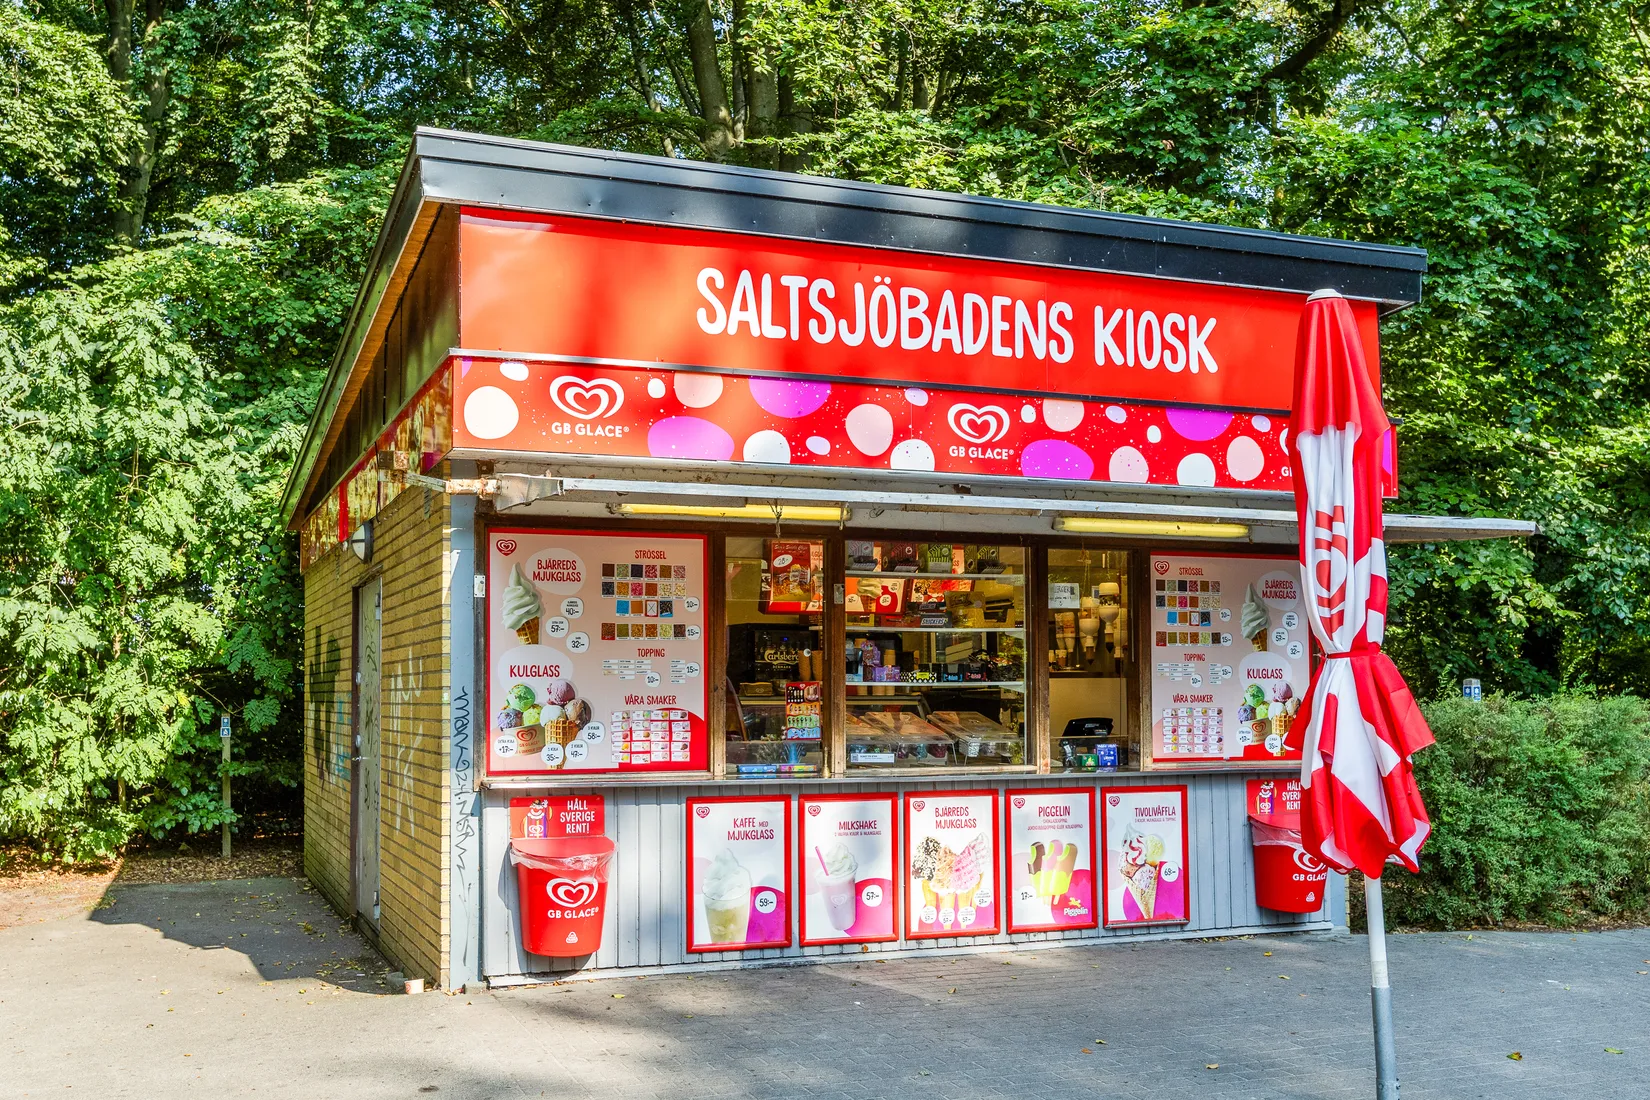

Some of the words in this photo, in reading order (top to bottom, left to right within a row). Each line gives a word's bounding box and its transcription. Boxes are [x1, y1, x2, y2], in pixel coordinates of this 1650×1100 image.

[696, 266, 1074, 365] SALTSJÖBADENS
[1094, 304, 1219, 375] KIOSK
[551, 421, 572, 436] GB
[948, 445, 966, 459] GB
[634, 550, 667, 560] STRÖSSEL
[537, 558, 577, 571] BJÄRREDS
[532, 571, 582, 582] MJUKGLASS
[1178, 566, 1204, 576] STRÖSSEL
[1265, 580, 1294, 590] BJÄRREDS
[1262, 590, 1297, 600] MJUKGLASS
[637, 648, 666, 658] TOPPING
[1184, 653, 1206, 662] TOPPING
[510, 664, 560, 678] KULGLASS
[1246, 668, 1283, 680] KULGLASS
[624, 694, 645, 706] VÅRA
[646, 695, 677, 705] SMAKER
[1172, 694, 1189, 703] VÅRA
[1190, 694, 1214, 703] SMAKER
[567, 798, 588, 810] HÅLL
[560, 811, 595, 822] SVERIGE
[935, 806, 969, 817] BJÄRREDS
[1038, 806, 1070, 817] PIGGELIN
[566, 822, 590, 834] RENT!
[733, 817, 756, 828] KAFFE
[839, 820, 877, 830] MILKSHAKE
[936, 818, 977, 829] MJUKGLASS
[728, 829, 774, 840] MJUKGLASS
[547, 909, 561, 919] GB
